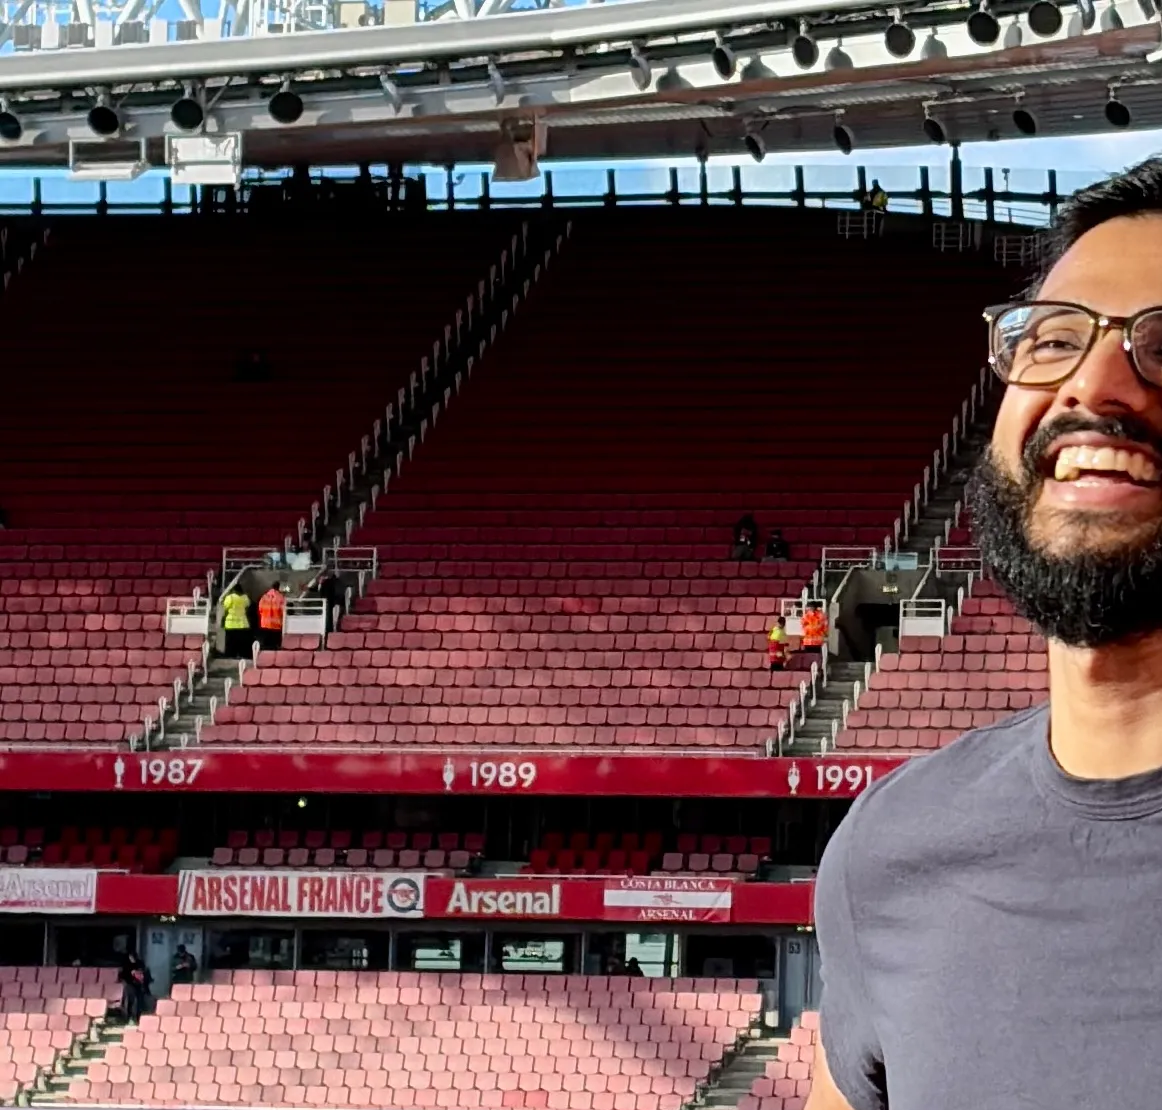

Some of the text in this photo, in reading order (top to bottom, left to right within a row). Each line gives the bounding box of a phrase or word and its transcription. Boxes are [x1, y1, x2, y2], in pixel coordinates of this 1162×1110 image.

[140, 759, 203, 785] 1987
[470, 761, 536, 788] 1989
[816, 765, 872, 790] 1991
[4, 872, 94, 897] Arsenal
[192, 875, 383, 914] ARSENAL FRANCE
[620, 879, 715, 890] COSTA BLANCA
[446, 882, 560, 915] Arsenal
[639, 909, 695, 920] ARSENAL
